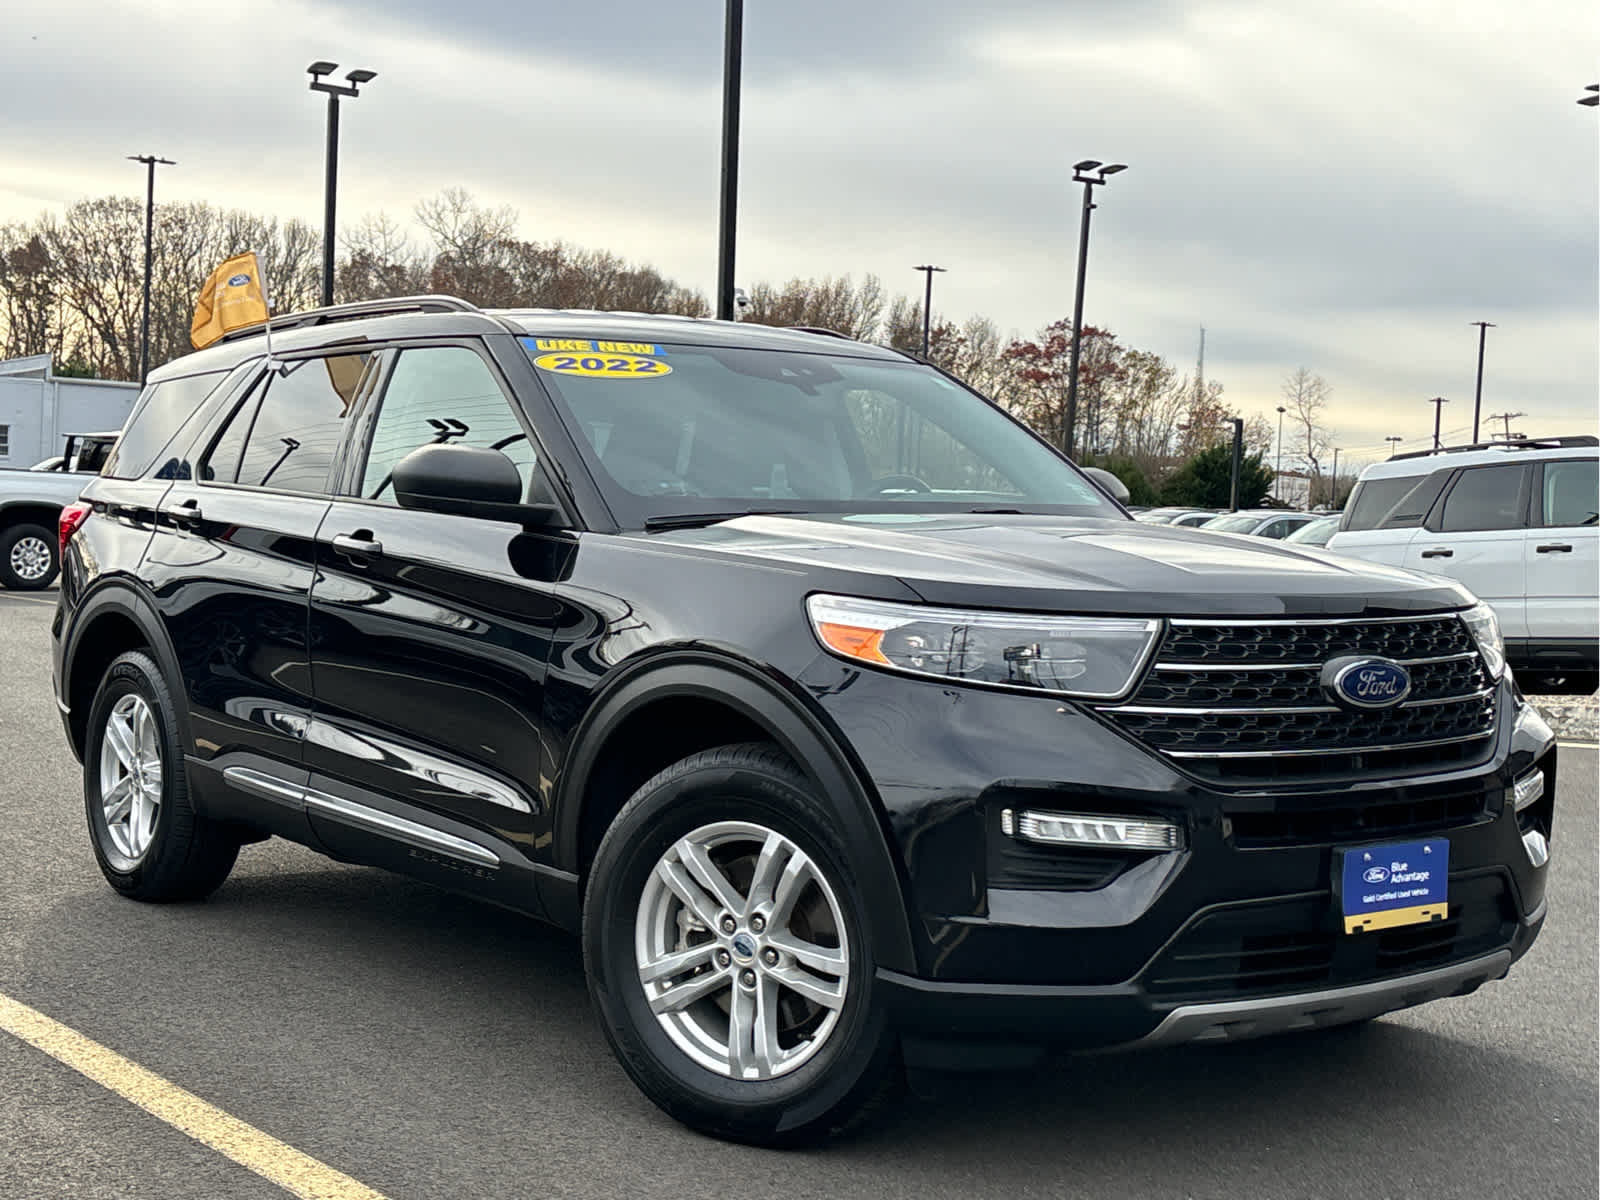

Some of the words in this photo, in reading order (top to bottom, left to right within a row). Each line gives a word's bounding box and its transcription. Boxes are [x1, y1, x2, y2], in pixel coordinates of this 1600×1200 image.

[598, 342, 655, 355] NEW
[553, 357, 659, 373] 2022
[1357, 669, 1397, 696] Ford
[1391, 862, 1408, 872] Blue
[1367, 871, 1385, 880] Ford
[1390, 871, 1430, 884] Advantage
